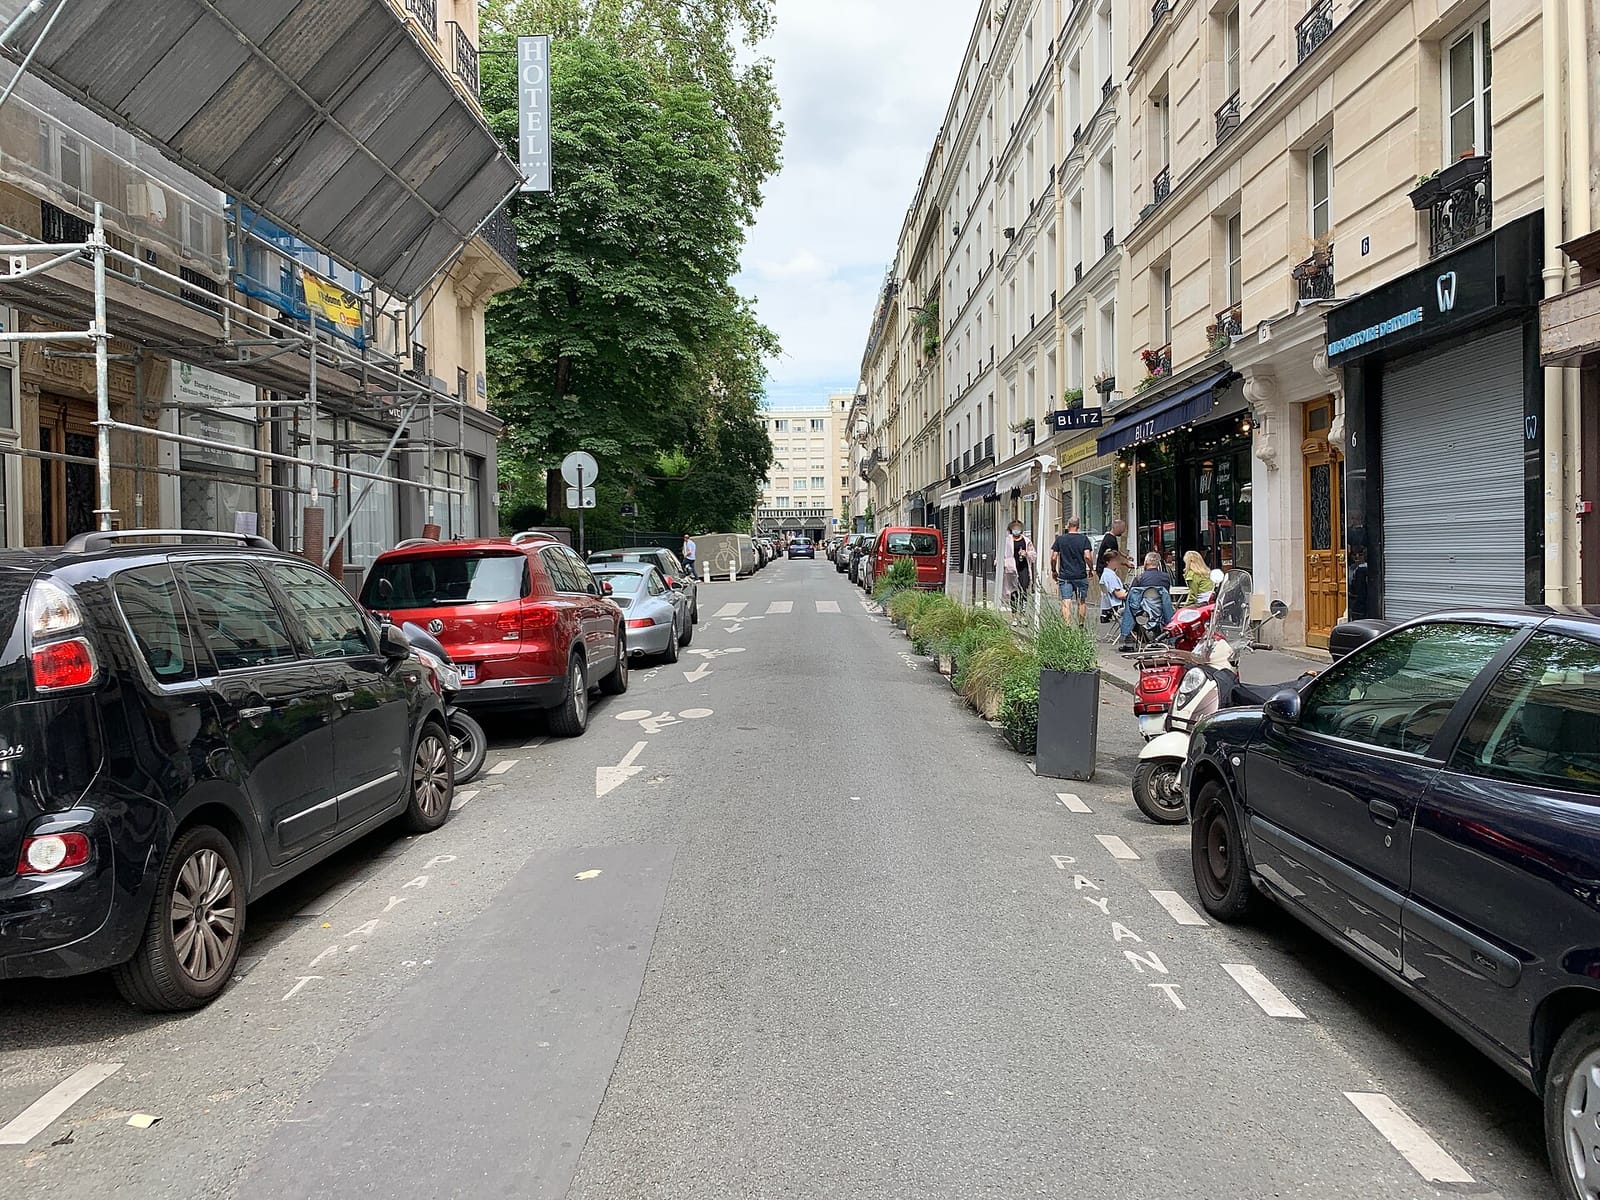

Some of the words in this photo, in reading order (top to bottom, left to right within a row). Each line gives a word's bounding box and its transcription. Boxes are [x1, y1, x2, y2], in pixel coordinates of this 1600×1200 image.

[522, 41, 544, 155] HOTEL
[1362, 238, 1369, 254] 6
[1351, 431, 1357, 447] 6
[1051, 855, 1187, 1010] PAYANT
